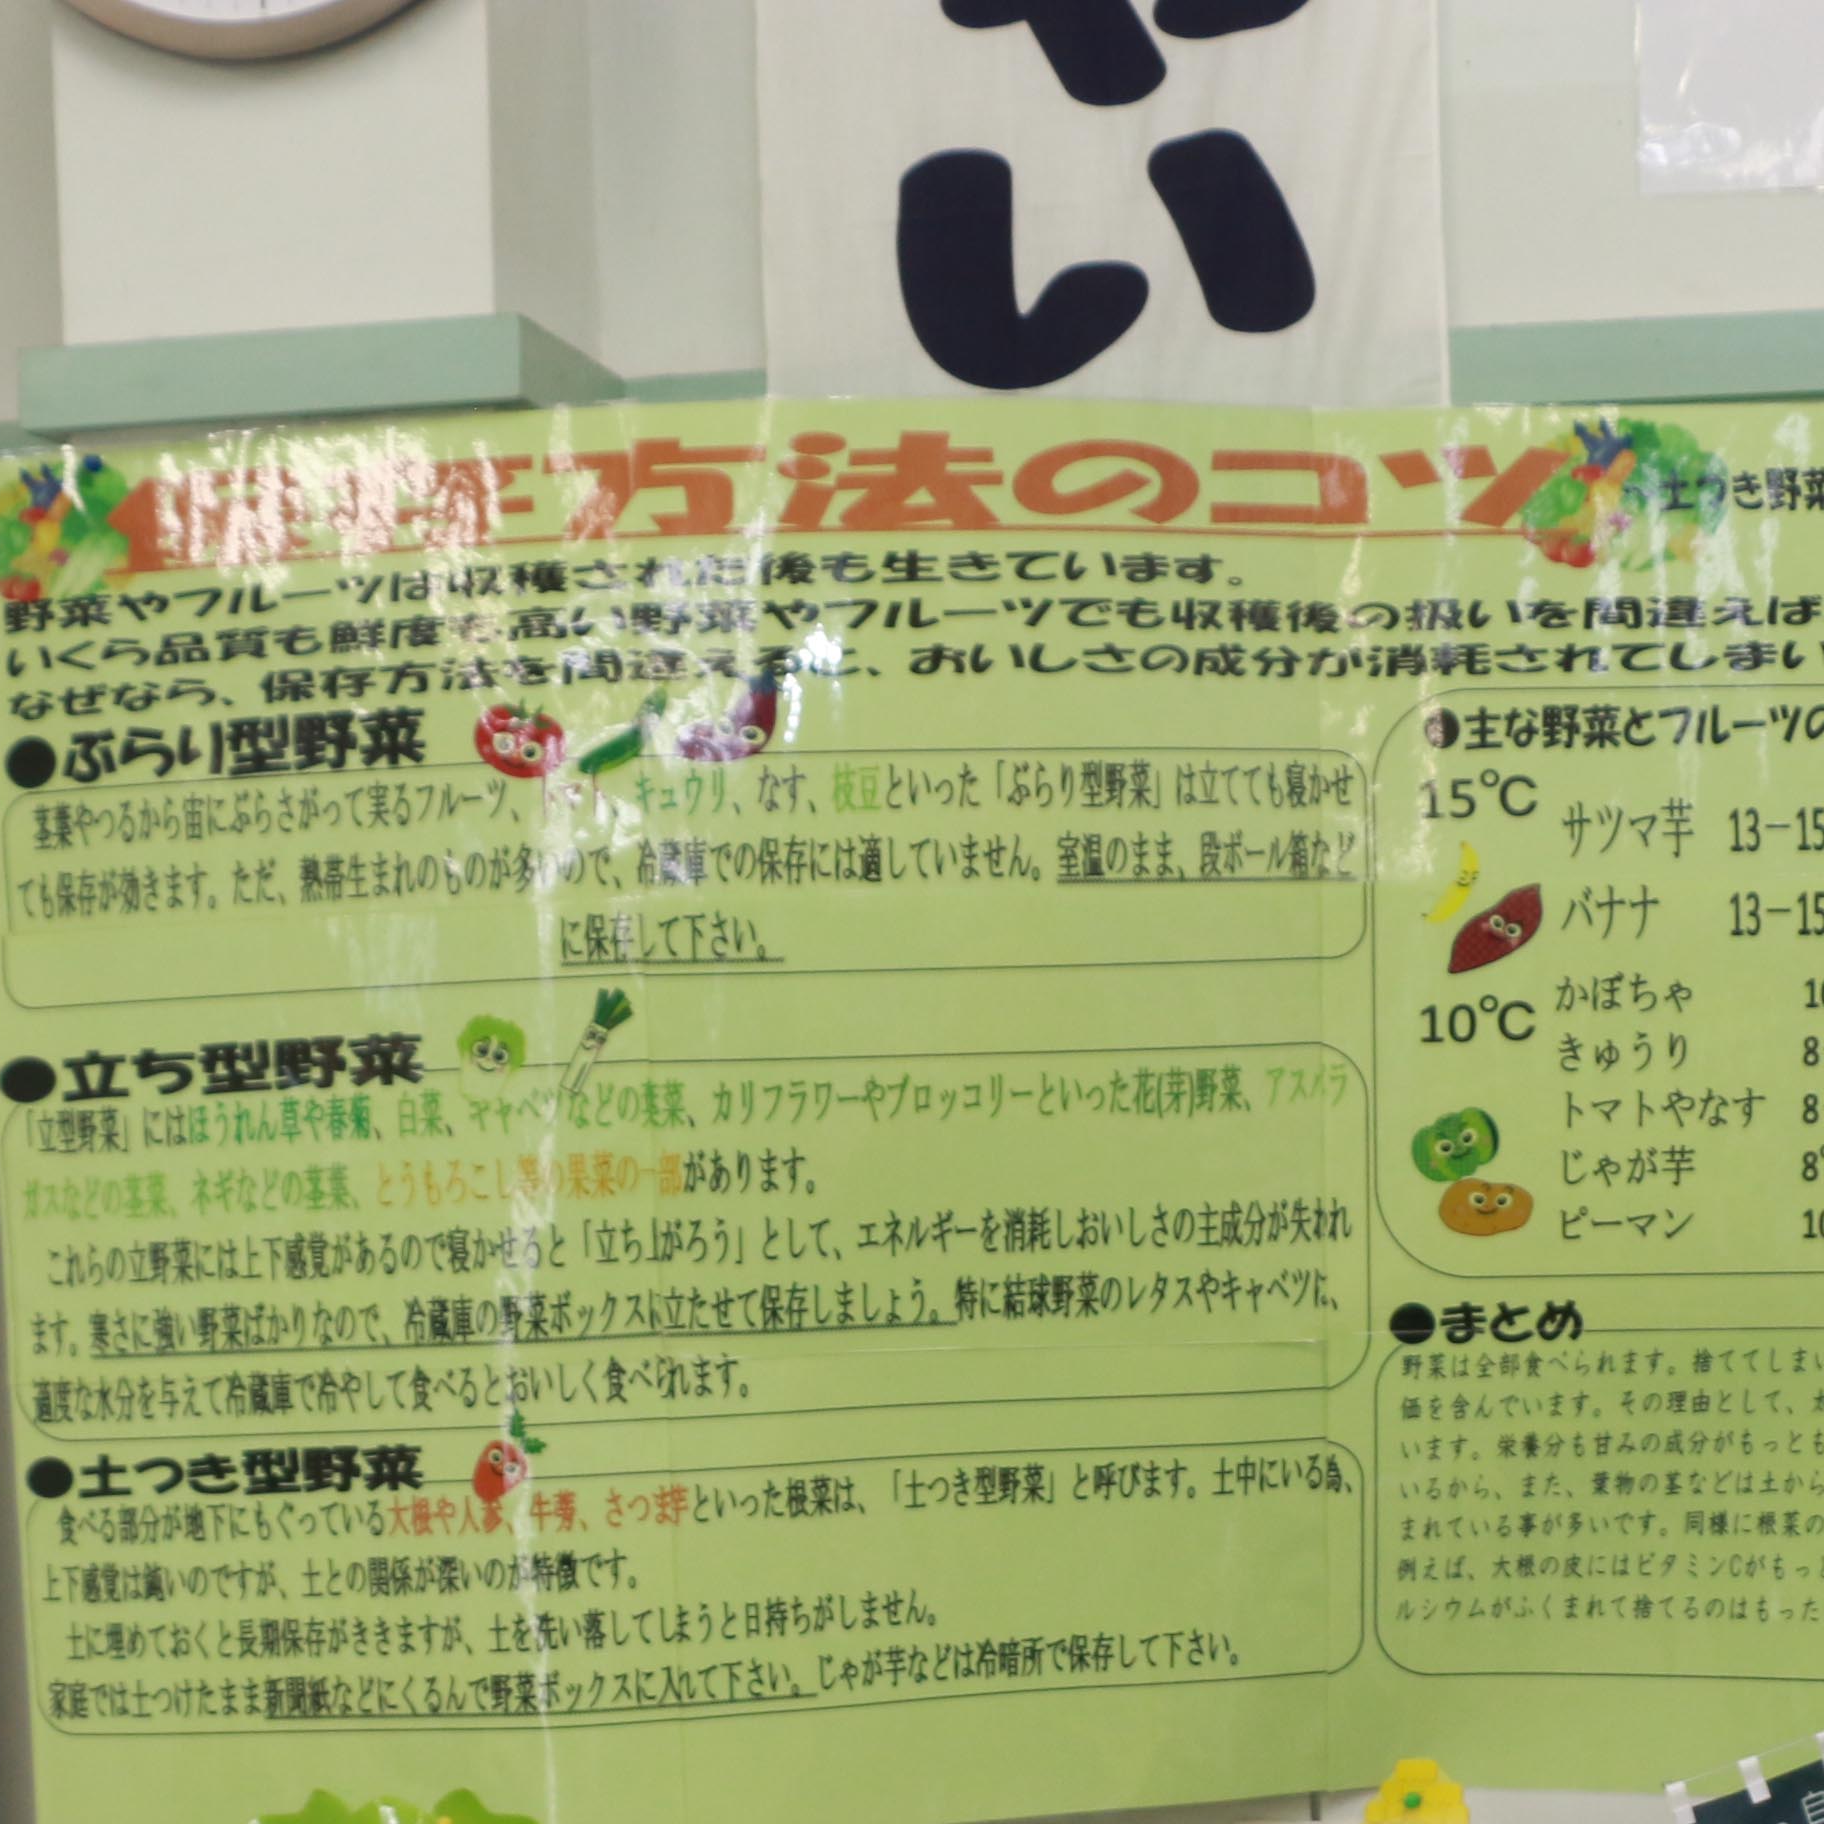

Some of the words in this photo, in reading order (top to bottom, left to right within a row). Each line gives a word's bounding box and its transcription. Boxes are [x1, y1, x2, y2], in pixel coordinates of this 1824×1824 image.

[1560, 798, 1695, 859] サツマ芋
[1560, 884, 1660, 941] バナナ
[1555, 973, 1693, 1014] かぼちゃ
[62, 1032, 424, 1102] 立ち型野菜
[1556, 1030, 1689, 1072] きゅうり
[1560, 1087, 1766, 1129] トマトやなす
[1560, 1146, 1695, 1186] じゃが芋
[1560, 1205, 1695, 1244] ピーマン
[1440, 1301, 1583, 1344] まとめ
[79, 1444, 424, 1499] 土つき型野菜
